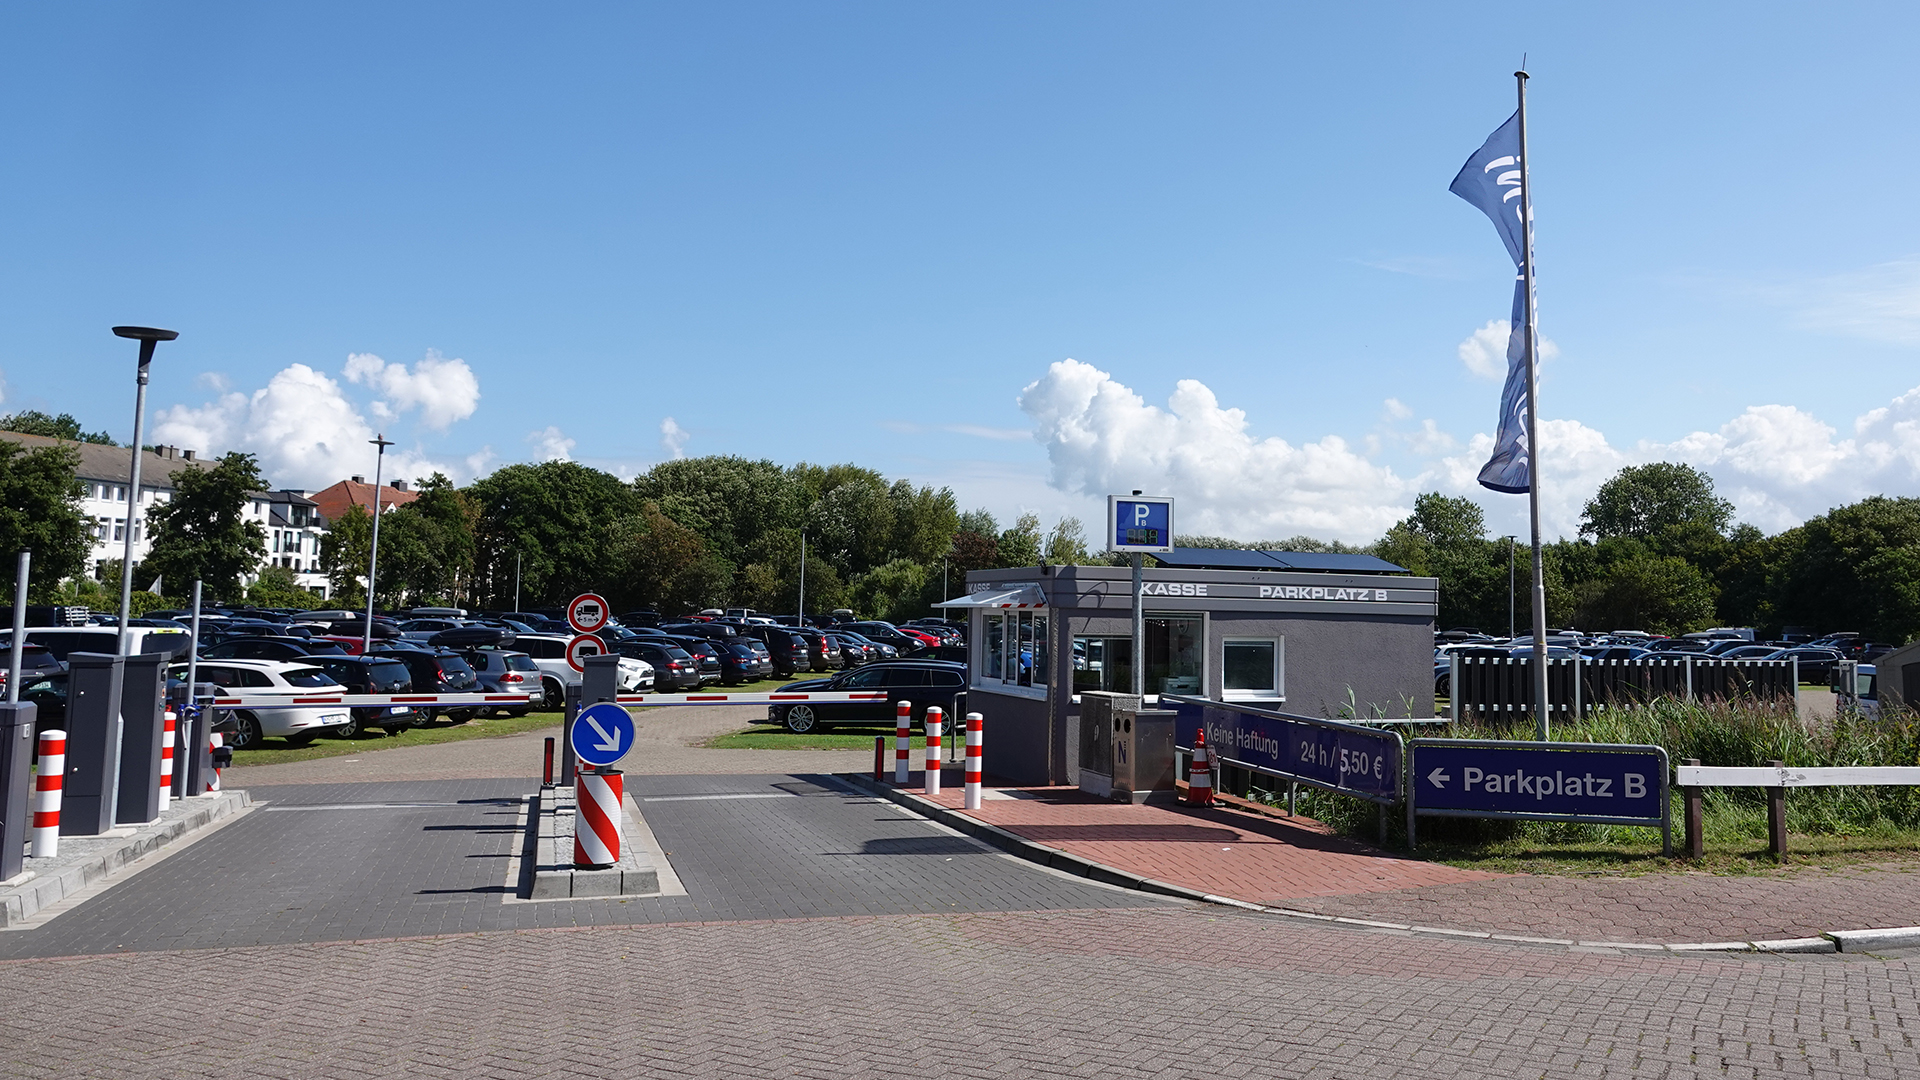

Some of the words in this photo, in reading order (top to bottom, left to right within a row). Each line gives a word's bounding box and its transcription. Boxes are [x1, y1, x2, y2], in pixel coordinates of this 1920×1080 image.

[1135, 504, 1150, 526] P
[1141, 519, 1147, 527] B
[1140, 582, 1208, 596] KASSE
[1259, 586, 1369, 601] PARKPLATZ
[1375, 589, 1388, 601] B
[1206, 721, 1234, 748] Keine
[1236, 727, 1279, 760] Haftung
[1301, 740, 1316, 764] 24
[1319, 744, 1327, 766] h
[1339, 748, 1369, 776] 5,50
[1373, 755, 1383, 780] €
[1463, 766, 1613, 800] Parkplatz
[1624, 772, 1647, 799] B
